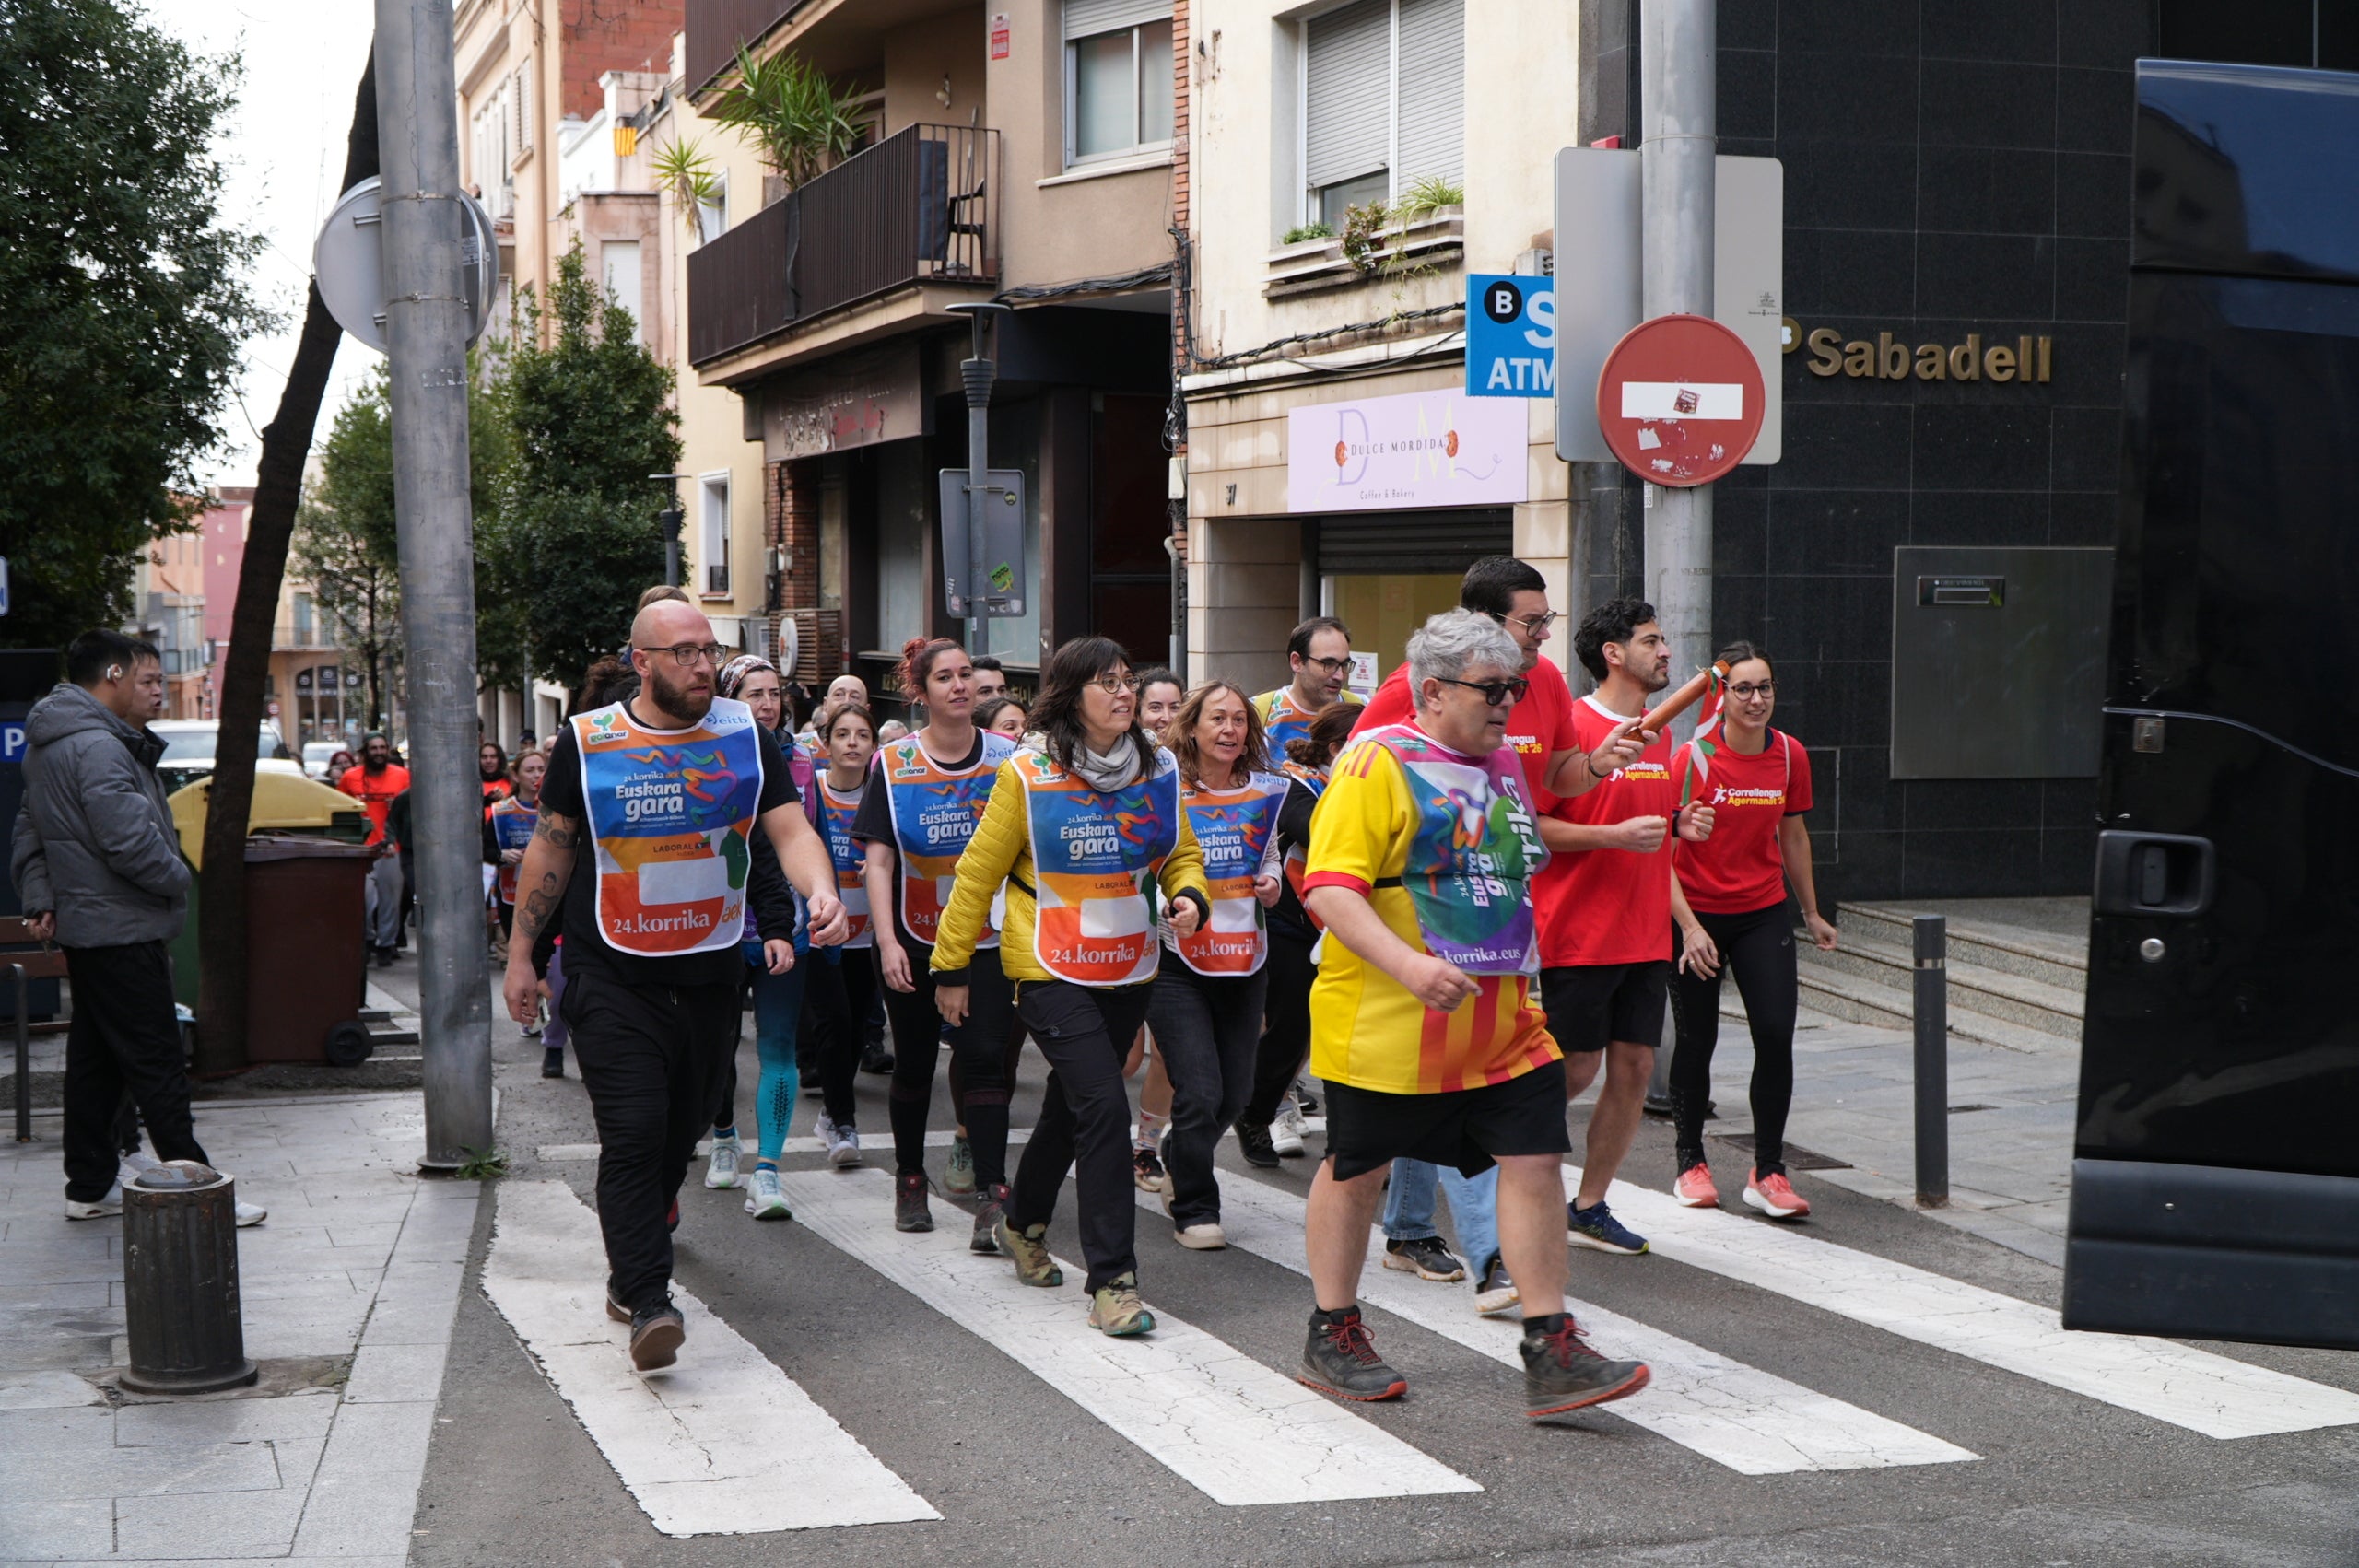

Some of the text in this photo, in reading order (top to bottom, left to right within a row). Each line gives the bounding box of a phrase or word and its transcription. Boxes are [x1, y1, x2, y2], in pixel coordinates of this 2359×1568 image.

[1807, 327, 2051, 383] Sabadell
[1486, 357, 1554, 391] ATM
[1351, 438, 1444, 456] DULCE MORDIDA
[1360, 490, 1381, 500] Coffee
[1392, 488, 1414, 499] Bakery
[719, 714, 748, 725] eitb
[4, 728, 25, 756] P
[616, 781, 682, 800] Euskara
[1728, 788, 1782, 799] Correllengua
[625, 795, 684, 823] gara
[1728, 797, 1777, 806] Agermanat
[919, 811, 970, 825] Euskara
[927, 822, 973, 844] gara
[1060, 823, 1116, 840] Euskara
[653, 842, 693, 853] LABORAL
[1069, 837, 1120, 860] gara
[1198, 835, 1240, 847] uskara
[613, 908, 710, 933] 24.korrika
[1050, 943, 1136, 965] 24.korrika
[1443, 947, 1521, 965] korrika.eus
